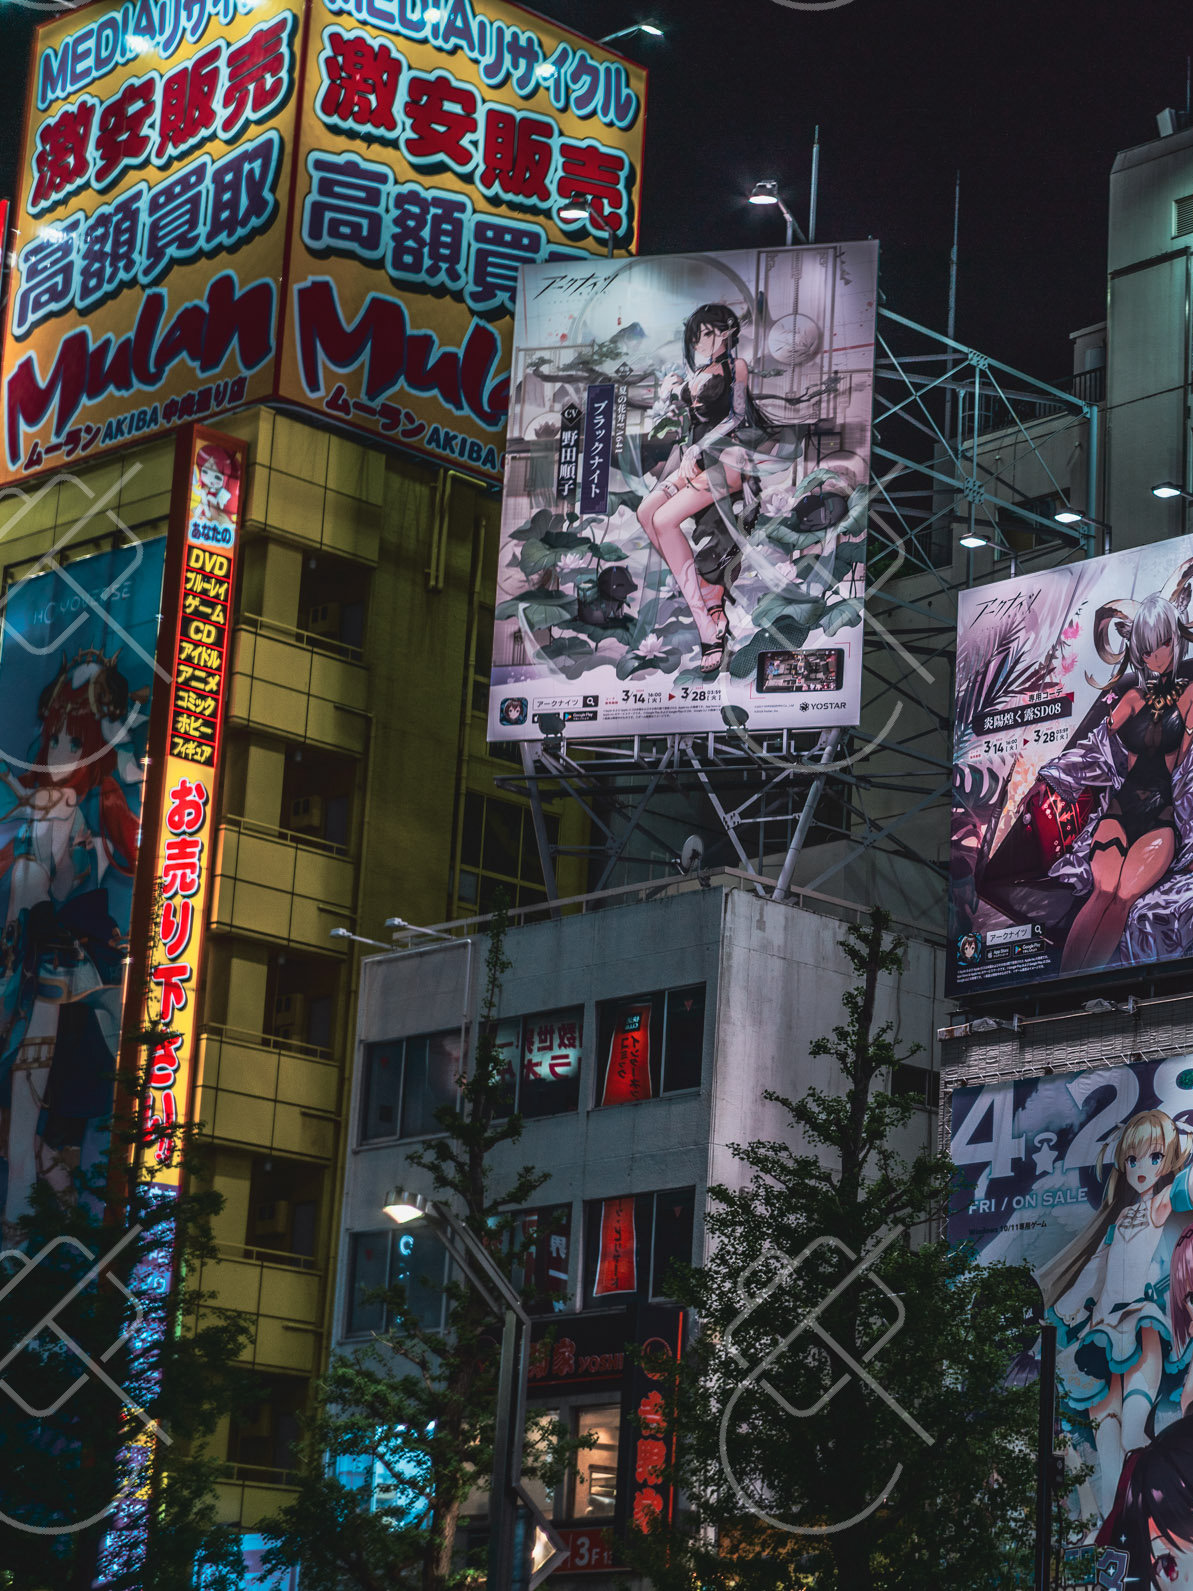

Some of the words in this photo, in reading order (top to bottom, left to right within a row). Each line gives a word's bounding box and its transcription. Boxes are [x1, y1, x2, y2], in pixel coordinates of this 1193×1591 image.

[27, 10, 292, 215] 激安販売
[314, 24, 629, 240] 激安販売
[12, 128, 281, 338] 高額買取
[301, 150, 592, 313] 高額買
[23, 424, 102, 473] ムーラン
[101, 403, 160, 445] AKIBA
[324, 384, 428, 441] ムーラン
[425, 425, 499, 473] AKIBA
[557, 429, 578, 497] 野田順子
[589, 400, 609, 500] ブラックナイト
[189, 520, 233, 546] あなたの
[189, 548, 228, 577] DVD
[186, 570, 229, 602] ブルーレイ
[184, 595, 226, 624] ゲーム
[189, 620, 217, 645] CD
[180, 641, 223, 670] アイドル
[177, 664, 221, 693] アニメ
[175, 689, 217, 716] コミック
[537, 698, 580, 708] アークナイツ
[811, 702, 847, 710] YOSTAR
[174, 713, 213, 737] ホビー
[172, 736, 214, 765] フィギュア
[990, 928, 1028, 943] アークナイツ
[968, 1198, 996, 1215] FRI
[1012, 1194, 1037, 1209] ON
[1042, 1187, 1089, 1206] SALE
